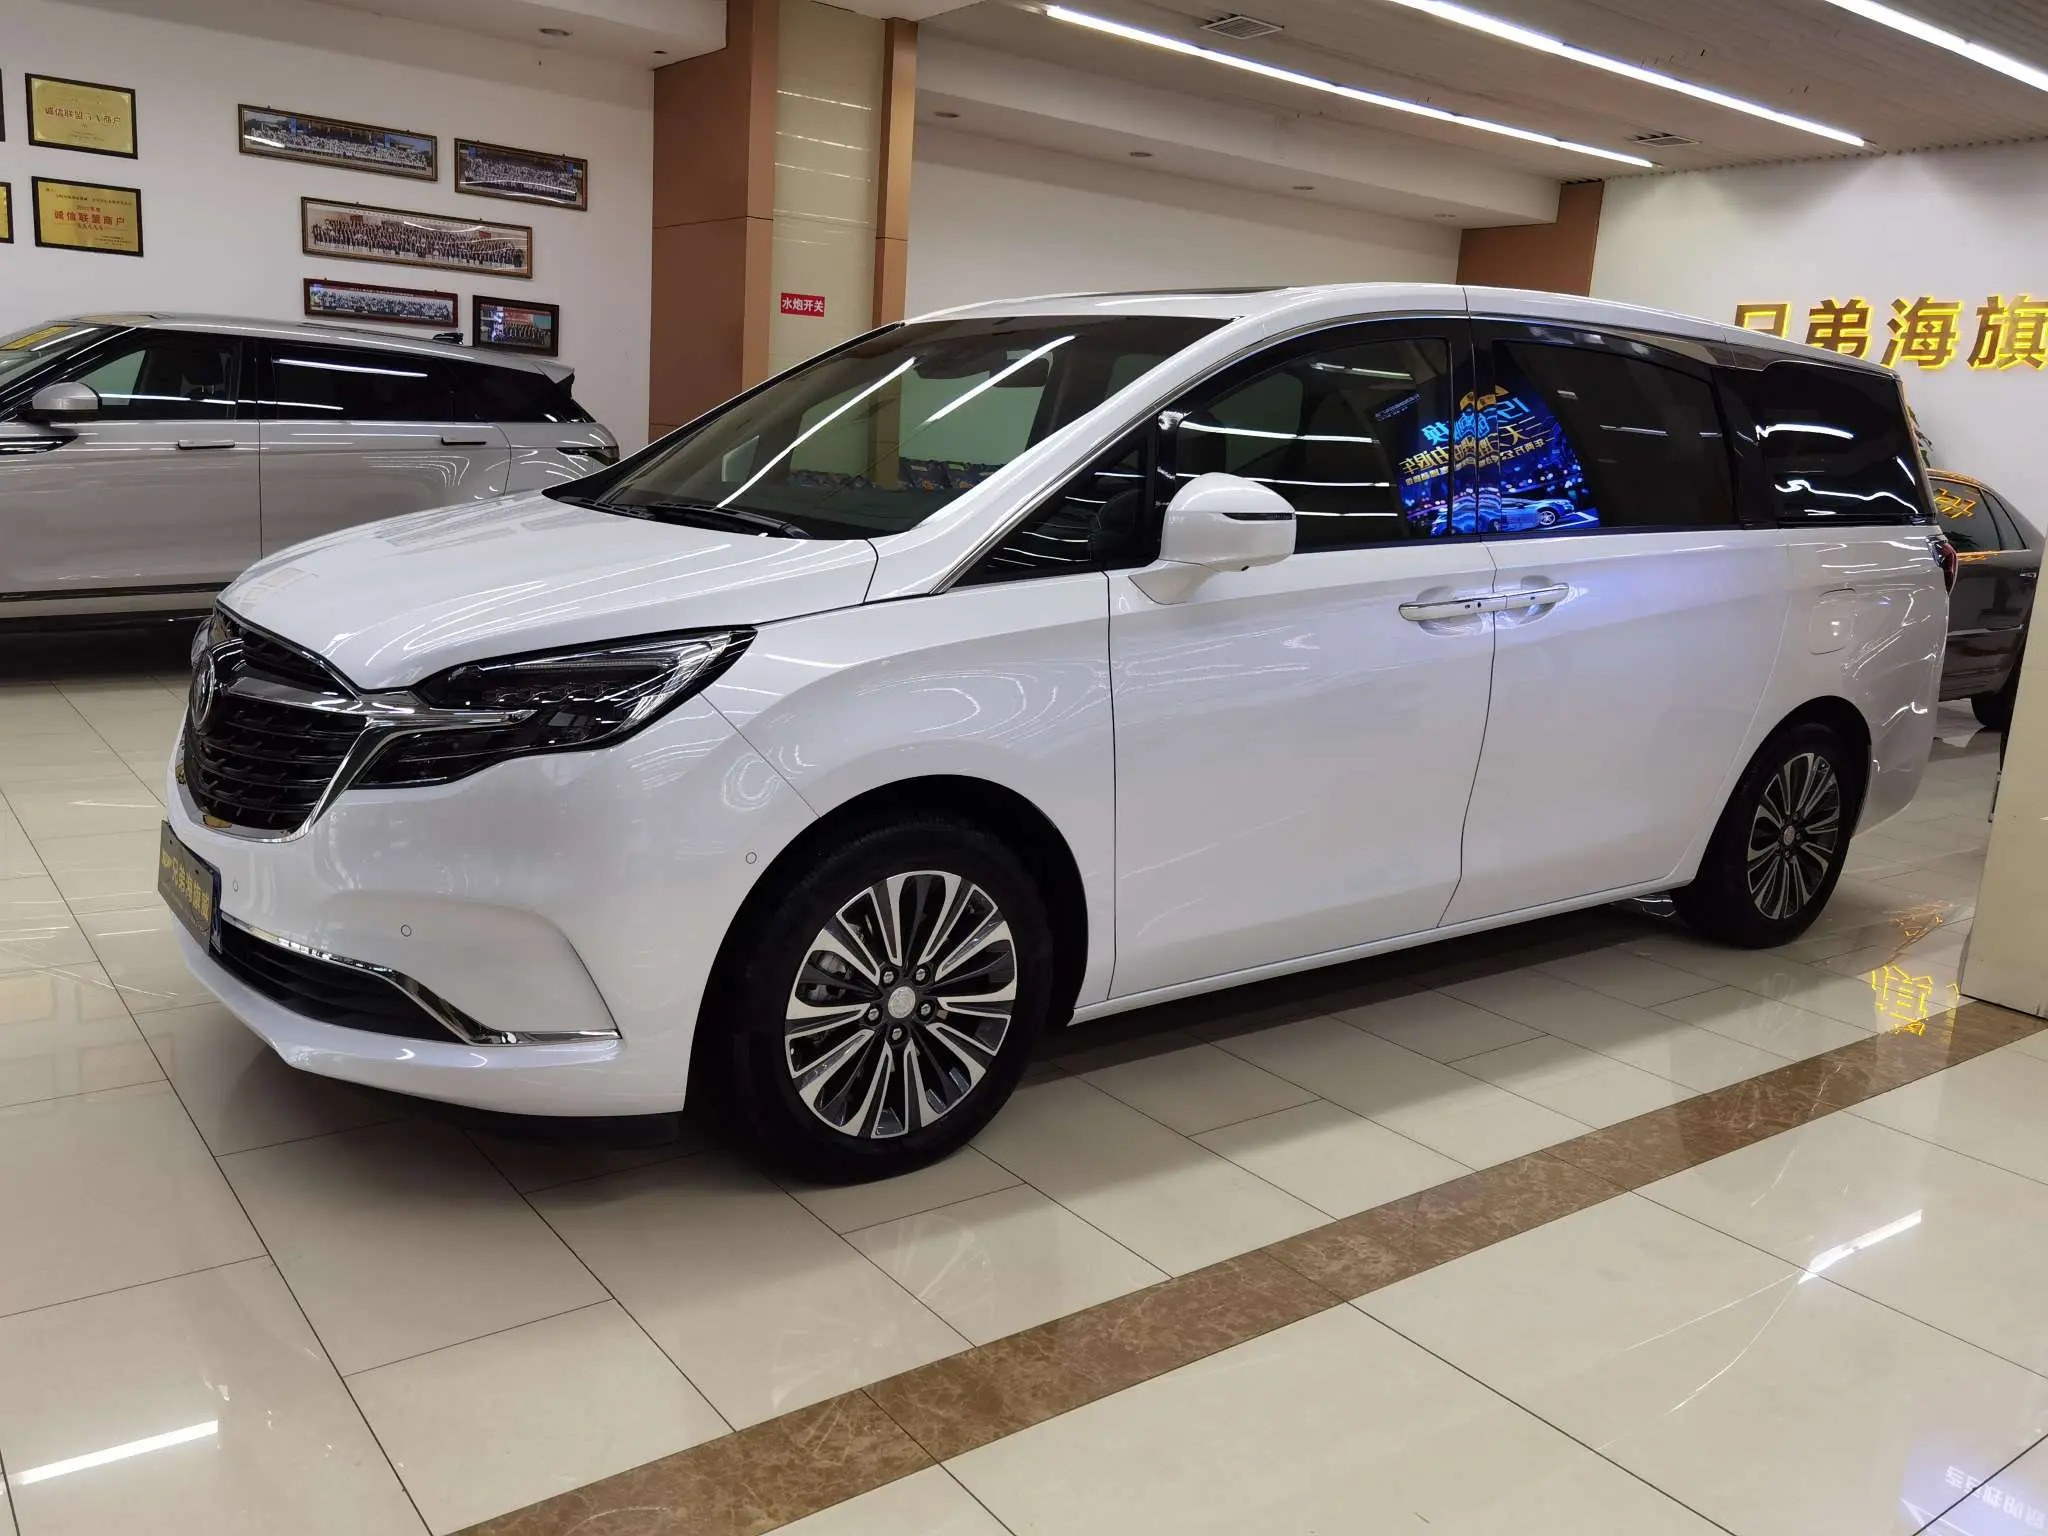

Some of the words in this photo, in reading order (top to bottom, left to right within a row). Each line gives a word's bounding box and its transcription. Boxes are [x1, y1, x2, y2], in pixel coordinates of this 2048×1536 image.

[54, 210, 125, 226] 诚信联盟商户
[782, 297, 824, 313] 水炮开关
